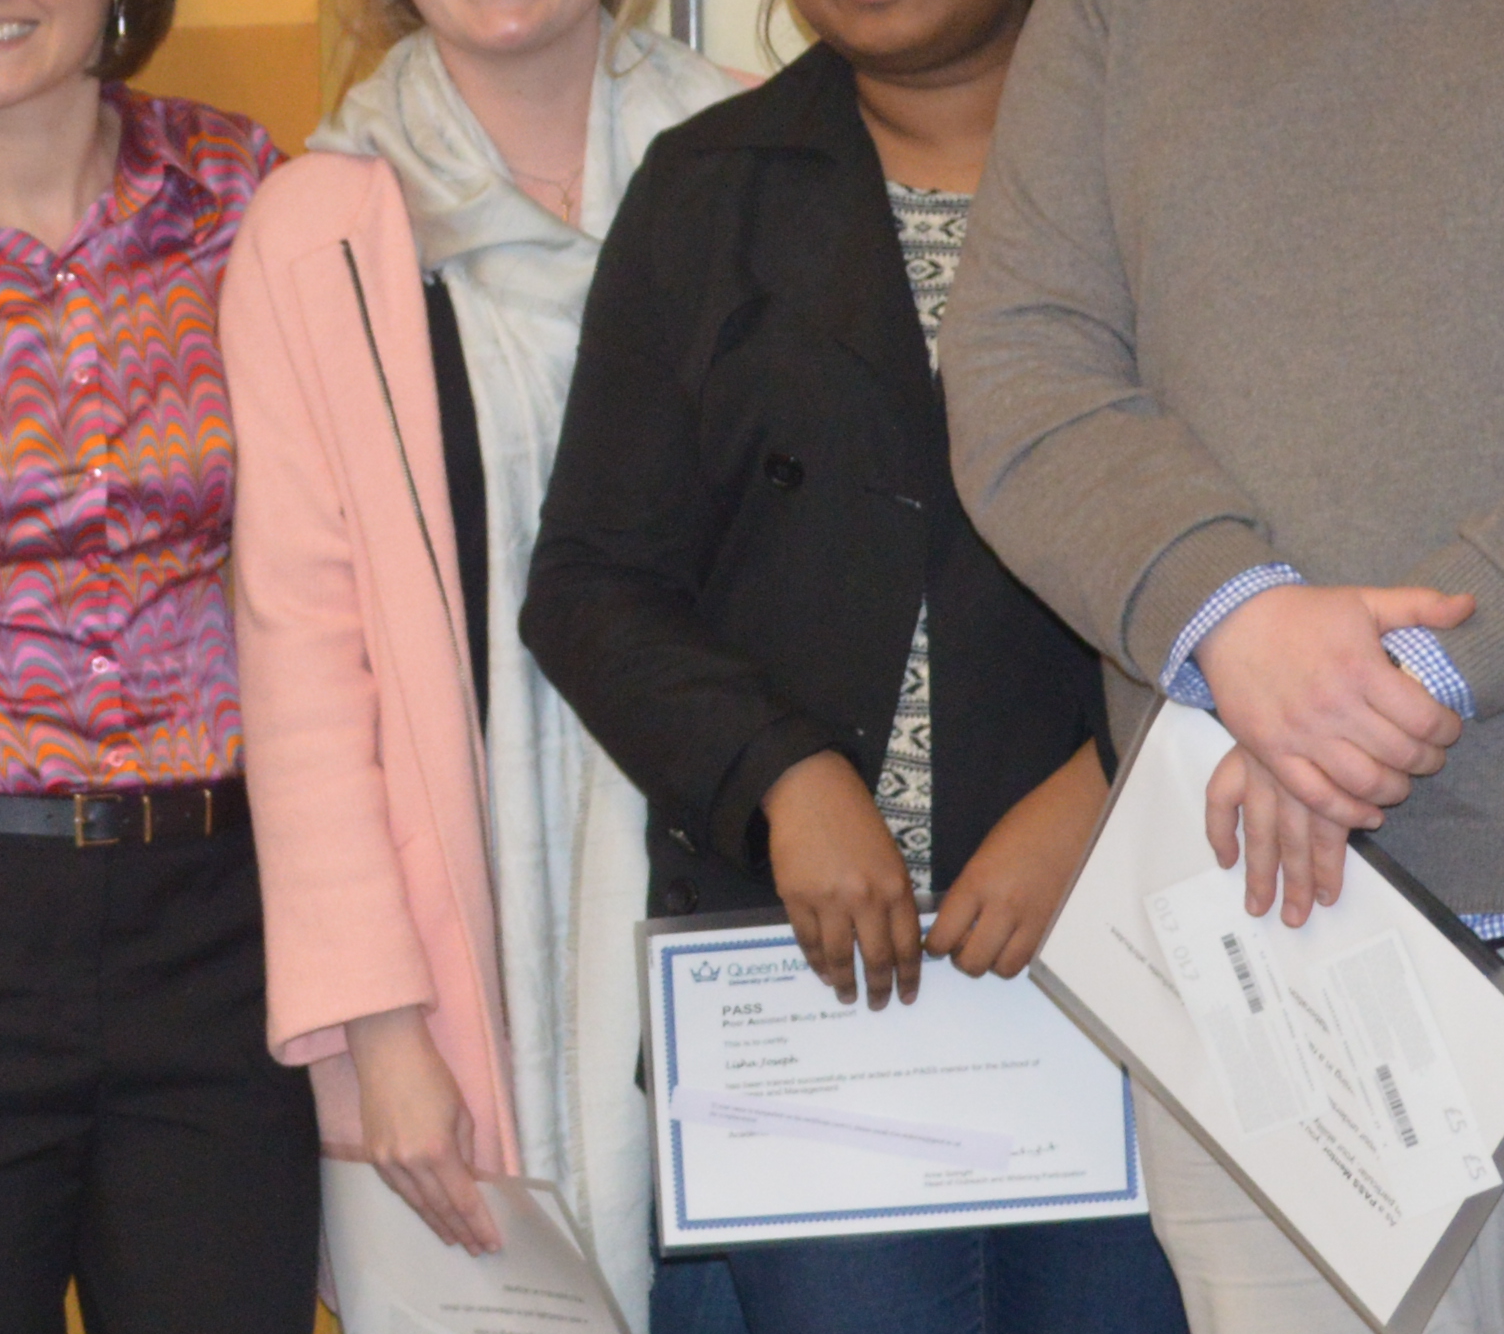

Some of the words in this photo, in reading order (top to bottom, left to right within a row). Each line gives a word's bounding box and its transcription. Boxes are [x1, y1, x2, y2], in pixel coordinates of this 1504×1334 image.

[726, 958, 778, 978] Queen
[721, 1001, 763, 1016] PASS
[1350, 1177, 1378, 1209] PASS
